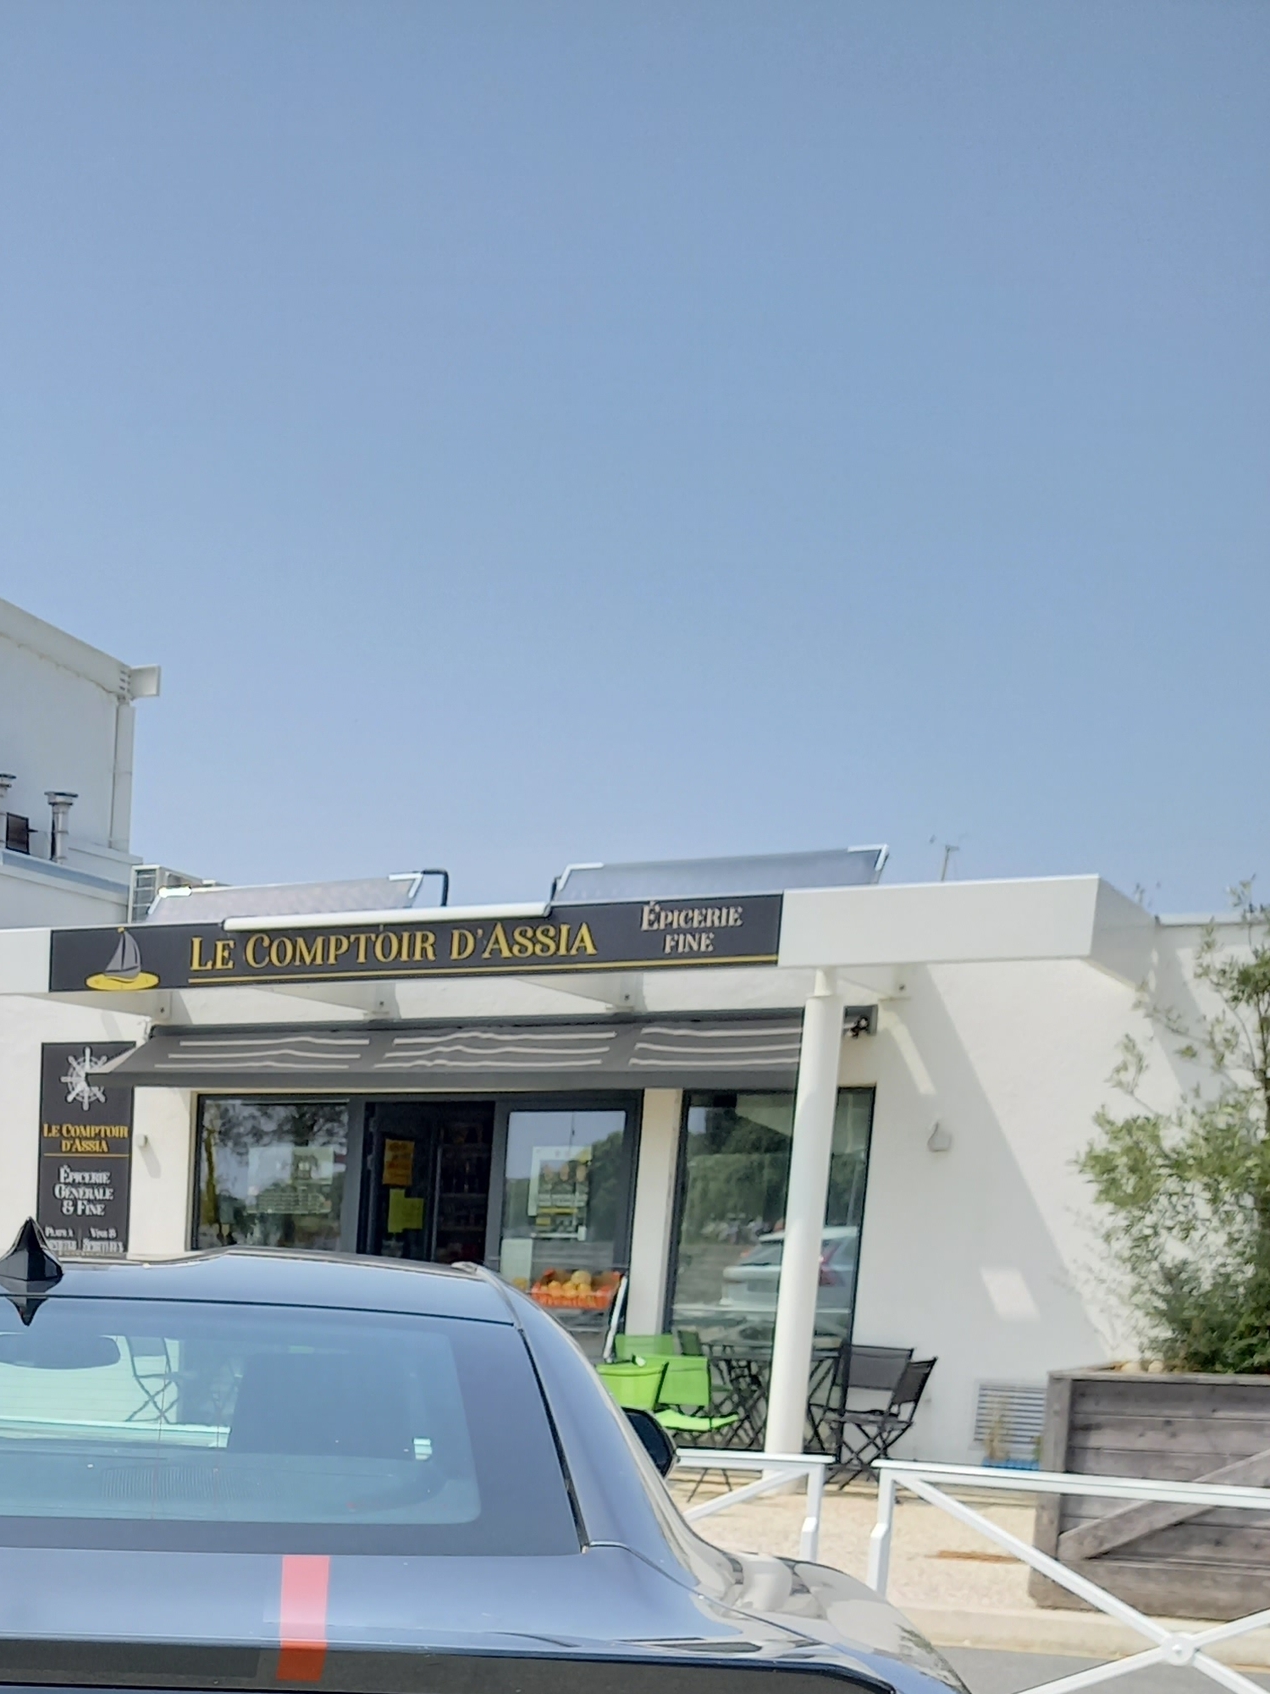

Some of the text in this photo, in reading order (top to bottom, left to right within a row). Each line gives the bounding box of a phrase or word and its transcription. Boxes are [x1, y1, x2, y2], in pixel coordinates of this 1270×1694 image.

[641, 901, 743, 931] ÉPICERIE
[190, 922, 597, 971] LE COMPTOIR D'ASSIA
[663, 932, 714, 954] FINE
[43, 1123, 129, 1138] LE COMPTOIR
[61, 1138, 109, 1152] D'ASSIA
[61, 1200, 106, 1216] & FINE
